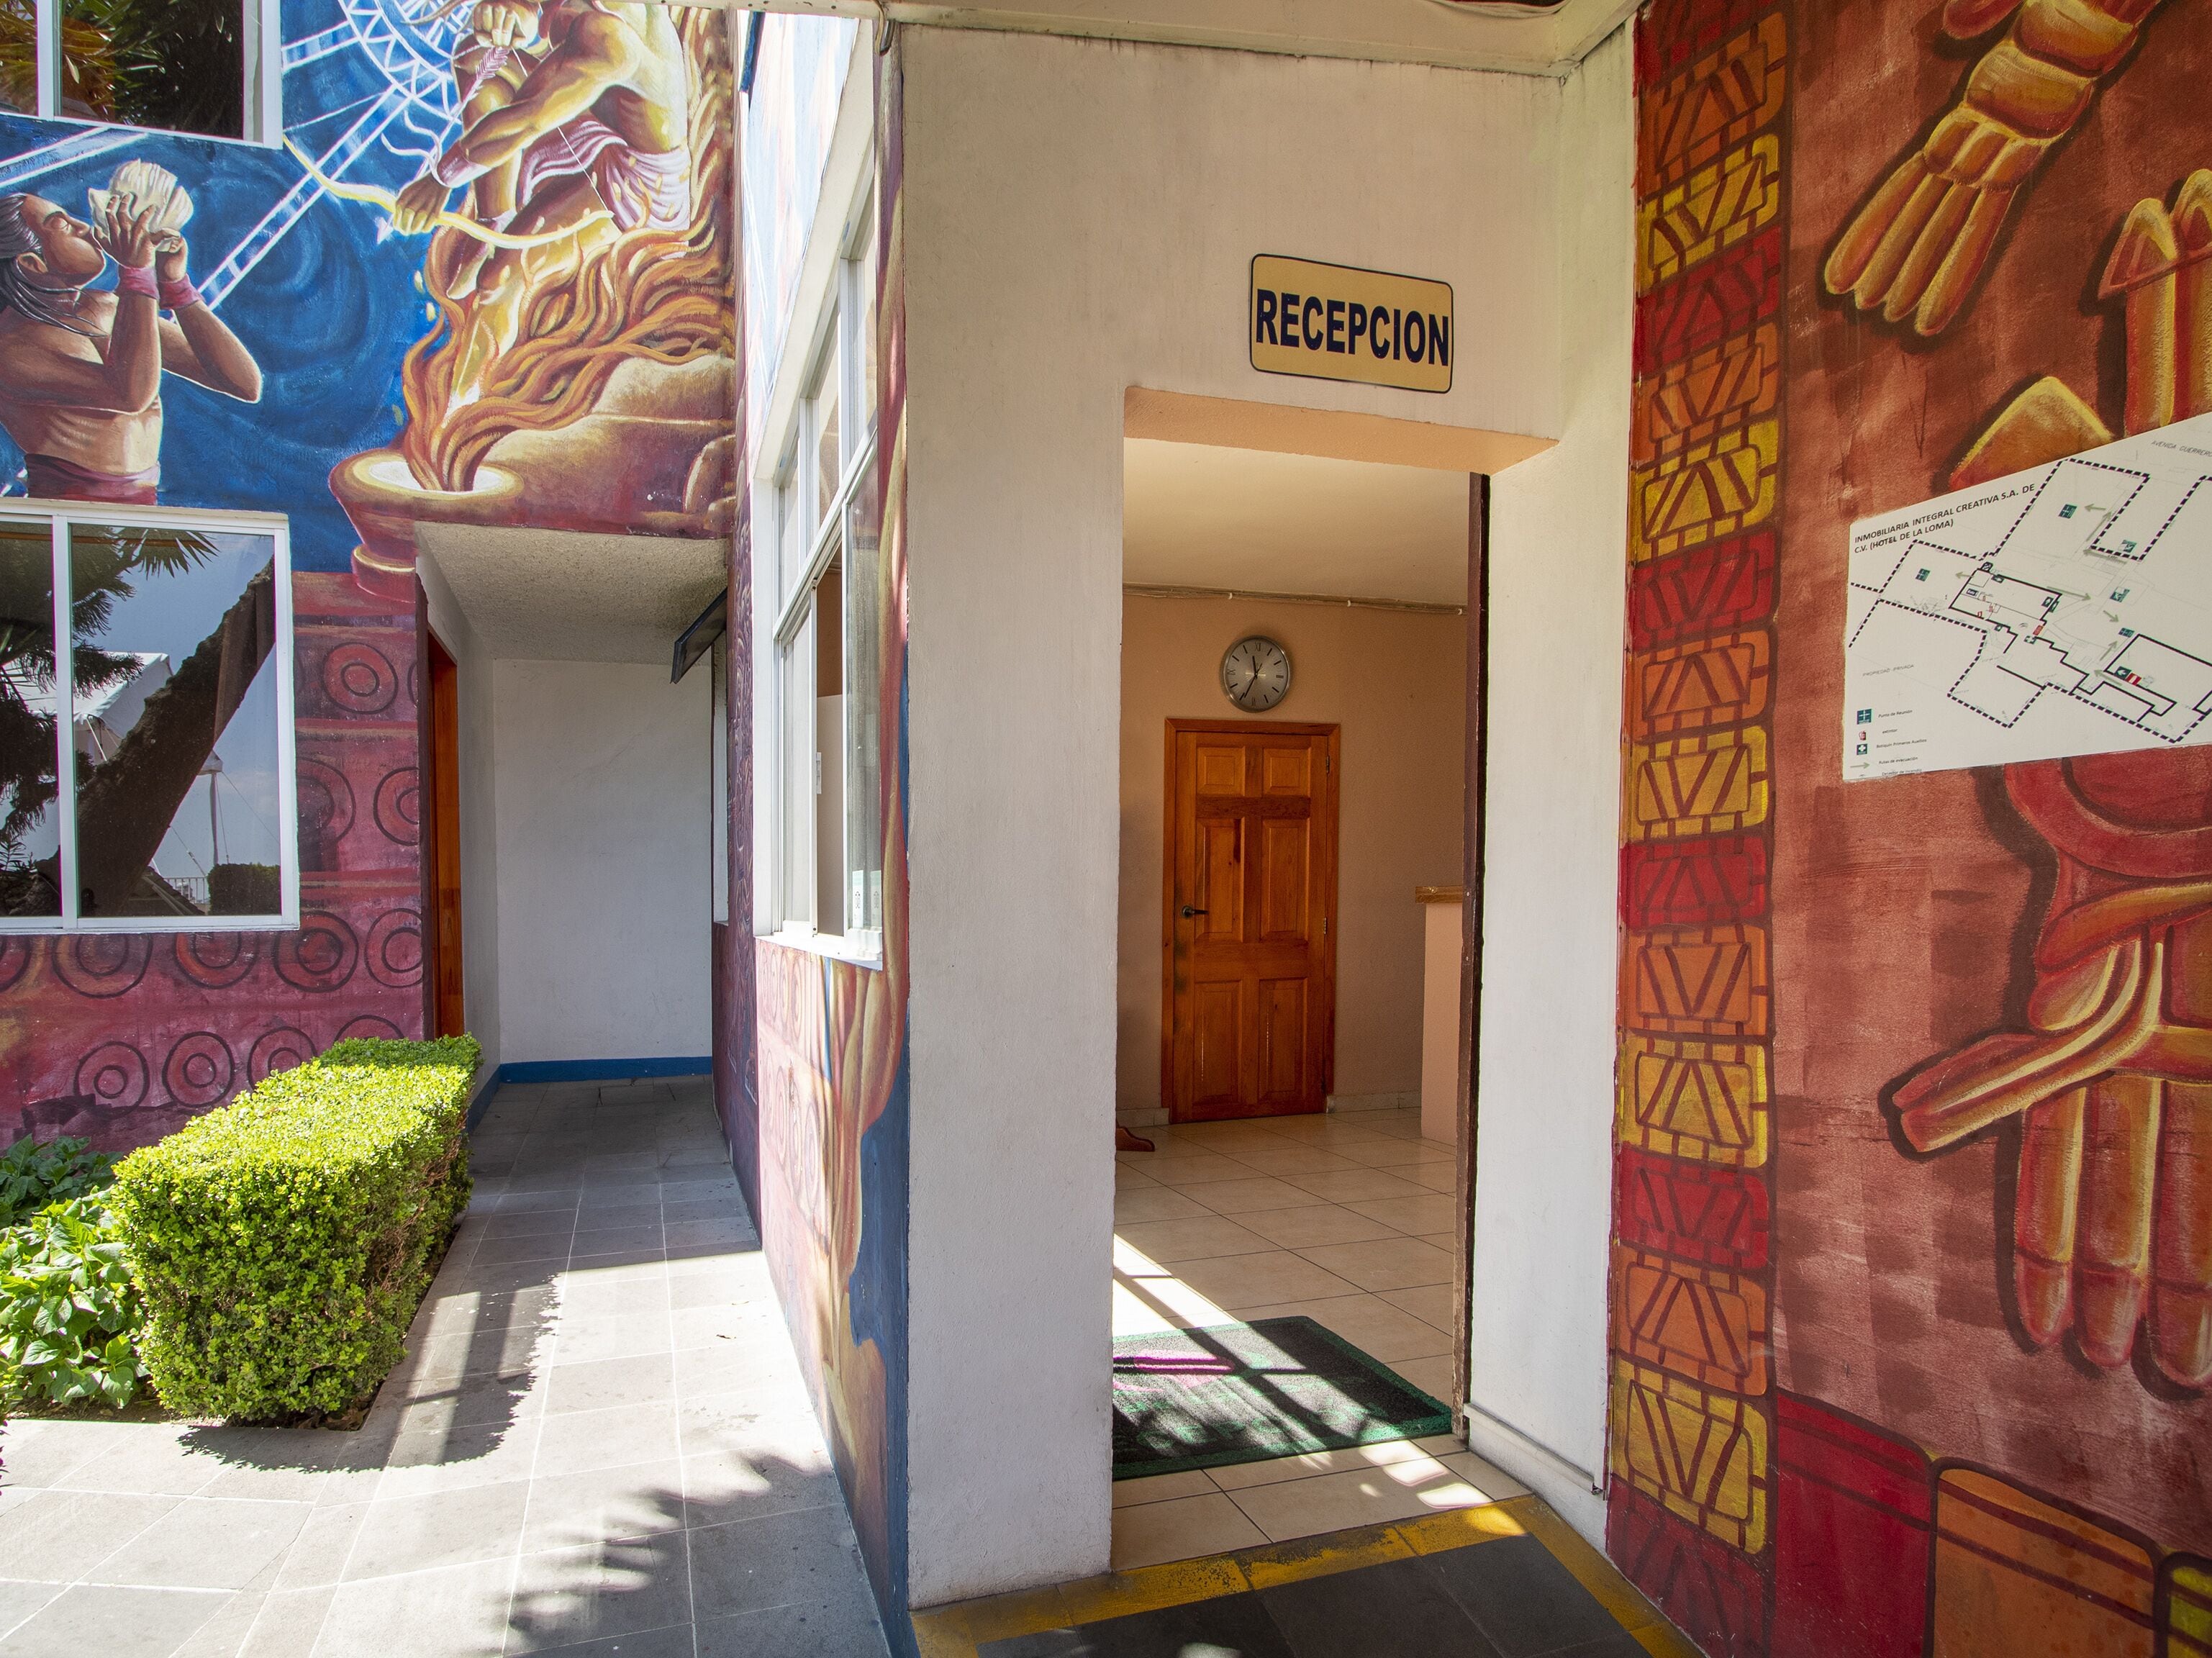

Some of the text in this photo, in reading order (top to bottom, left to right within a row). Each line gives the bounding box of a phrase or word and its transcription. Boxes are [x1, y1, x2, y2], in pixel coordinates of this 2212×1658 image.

[1256, 288, 1449, 367] RECEPCION
[2151, 440, 2177, 449] AVENIDA
[1854, 483, 2036, 543] INMOBILIARIA INTEGRAL CREATIVA S.A. DE
[1854, 518, 1954, 553] C.V. (HOTEL DE LA LOMA)
